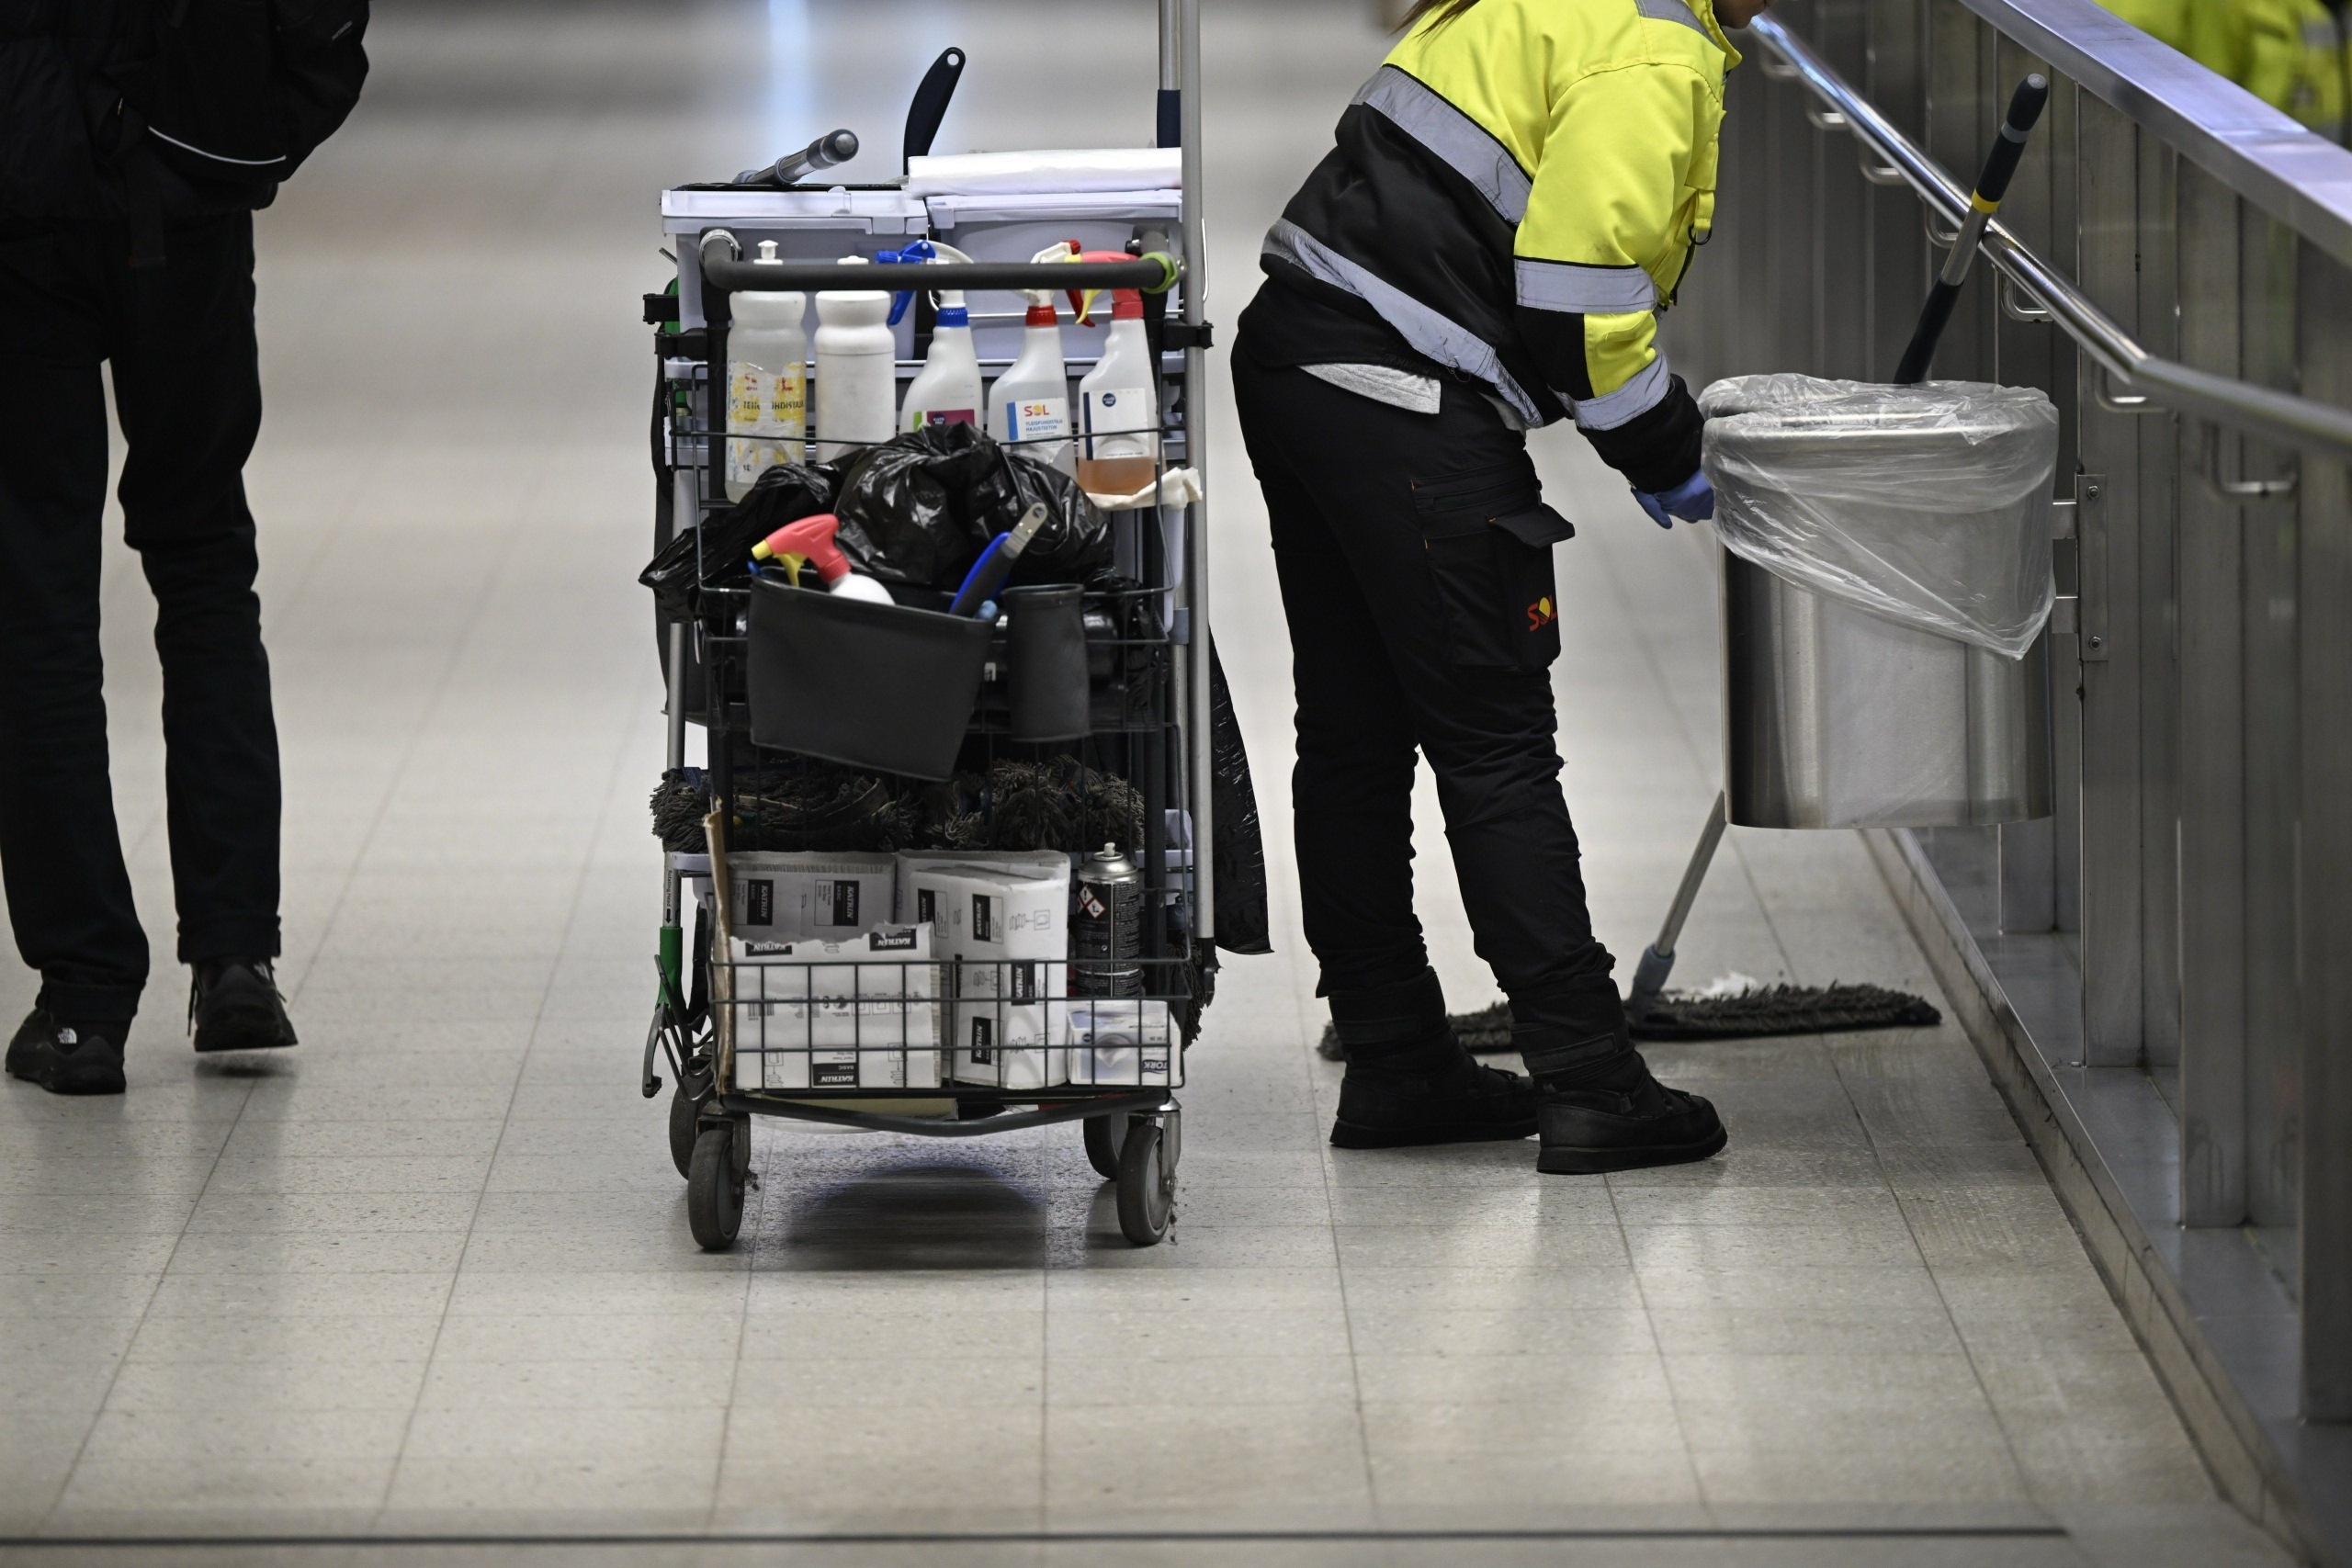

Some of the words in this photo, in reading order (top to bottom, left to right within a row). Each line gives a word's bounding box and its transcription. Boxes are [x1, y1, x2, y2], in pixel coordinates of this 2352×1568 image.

[1023, 404, 1049, 417] SOL
[1528, 594, 1558, 632] SOL
[761, 885, 769, 919] KATRIN
[846, 886, 854, 919] KATRIN
[877, 938, 911, 946] KATRIN
[1143, 1060, 1168, 1070] TORK
